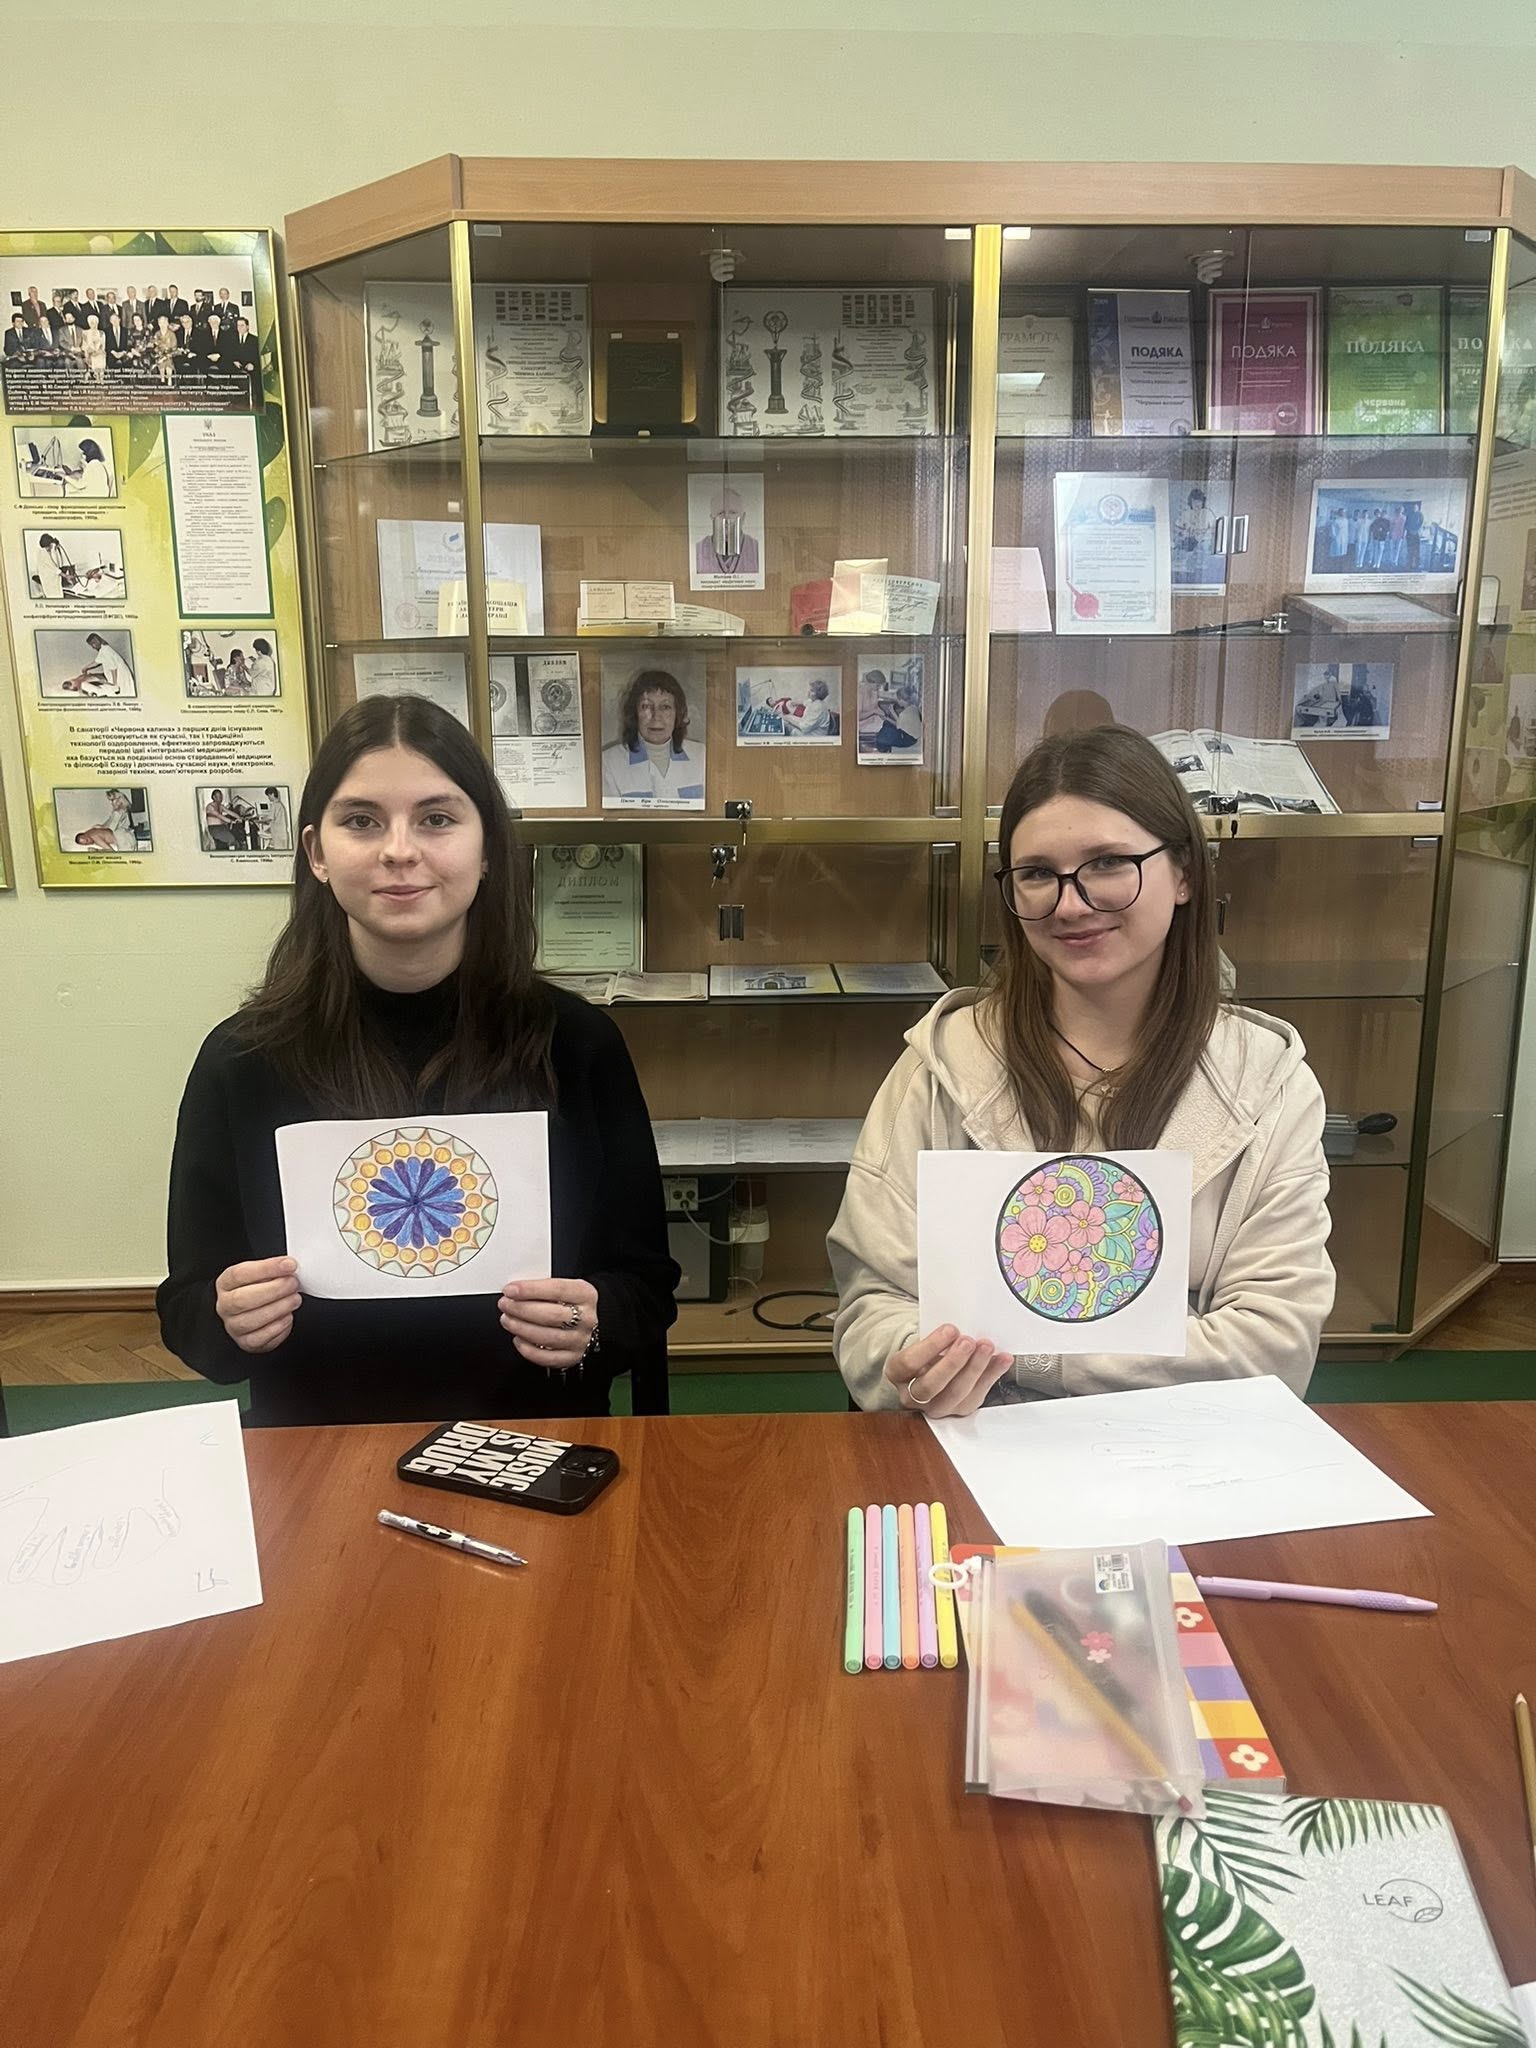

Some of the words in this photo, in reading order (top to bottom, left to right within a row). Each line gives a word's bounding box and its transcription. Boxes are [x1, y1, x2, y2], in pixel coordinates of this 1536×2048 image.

[1131, 346, 1183, 359] ПОДЯКА
[1231, 344, 1297, 359] ПОДЯКА
[1346, 340, 1425, 355] ПОДЯКА
[557, 876, 619, 888] ДИПЛОМ
[489, 1429, 537, 1450] IS
[402, 1421, 500, 1476] DRUG
[453, 1448, 517, 1484] MY
[488, 1436, 573, 1492] MUSIC
[1363, 1893, 1412, 1907] LEAF
